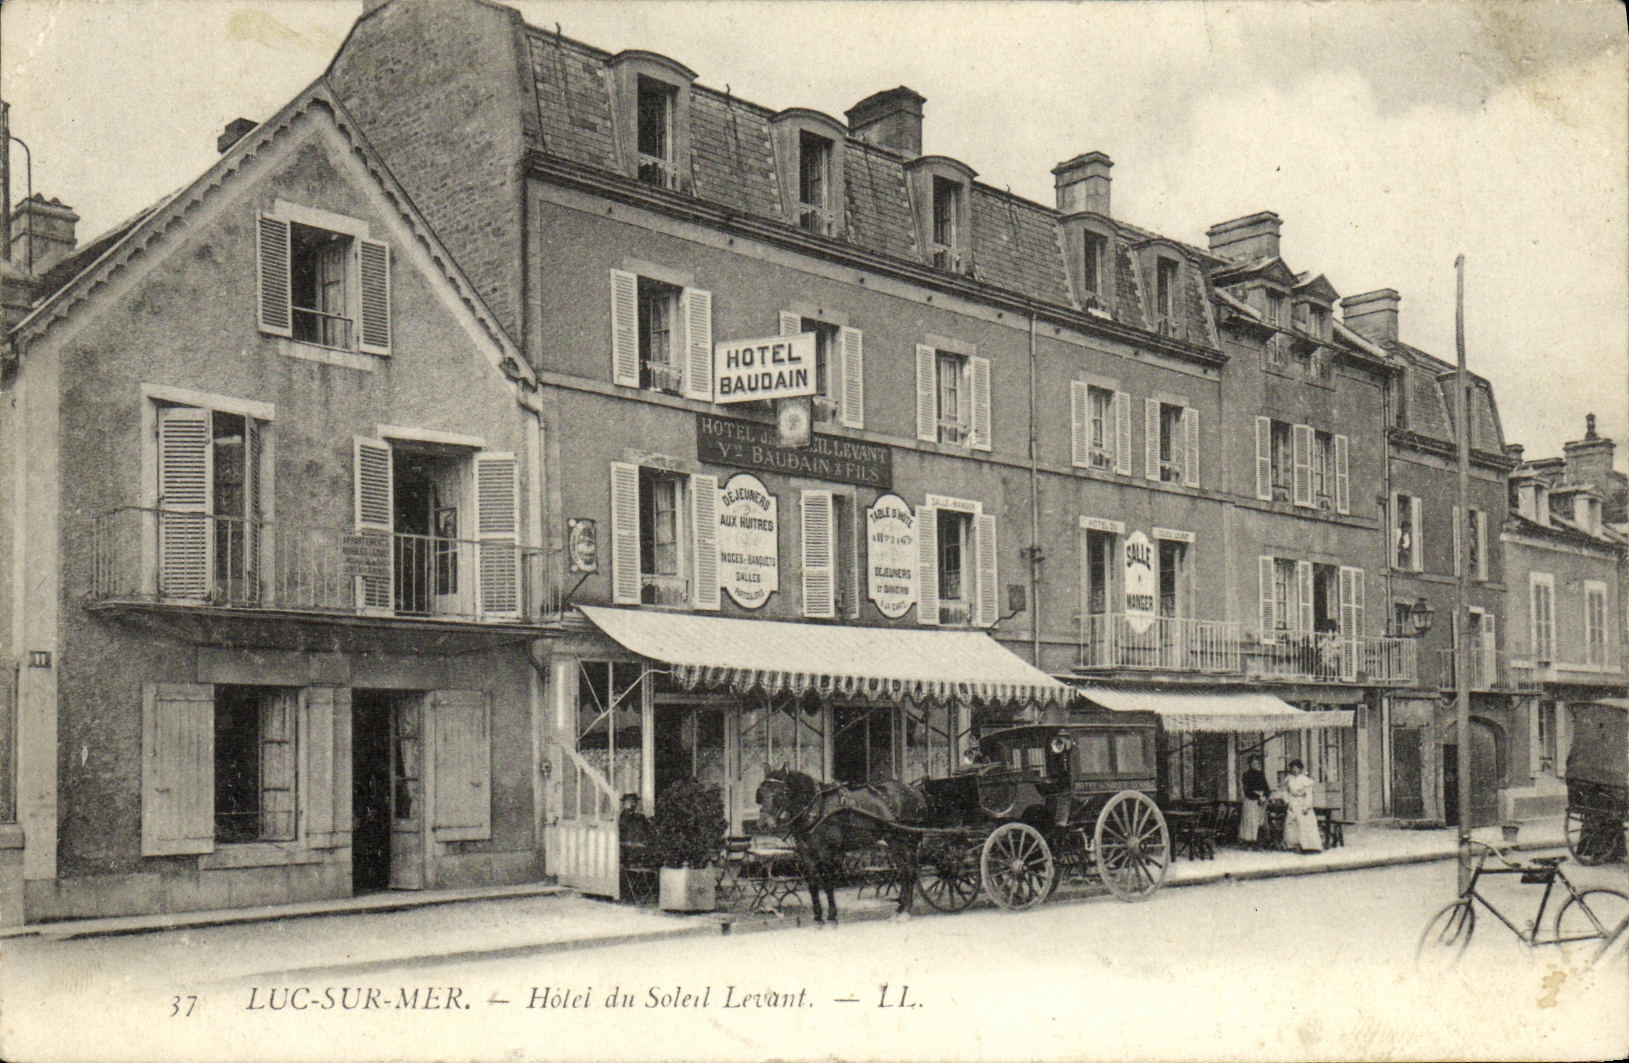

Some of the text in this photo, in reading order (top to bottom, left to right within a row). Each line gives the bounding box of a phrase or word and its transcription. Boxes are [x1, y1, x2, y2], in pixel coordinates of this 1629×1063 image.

[727, 343, 802, 369] HOTEL
[720, 368, 808, 395] BAUDAIN
[702, 417, 755, 443] HOTEL
[834, 440, 887, 464] LEVANT
[752, 446, 829, 475] BAUDAIN
[846, 466, 879, 483] FILS
[721, 488, 771, 511] DEJEUNERS
[720, 514, 774, 532] AUX HUITRES
[870, 507, 891, 523] TABLE
[1126, 542, 1151, 571] SALLE
[1126, 593, 1153, 612] MANGER
